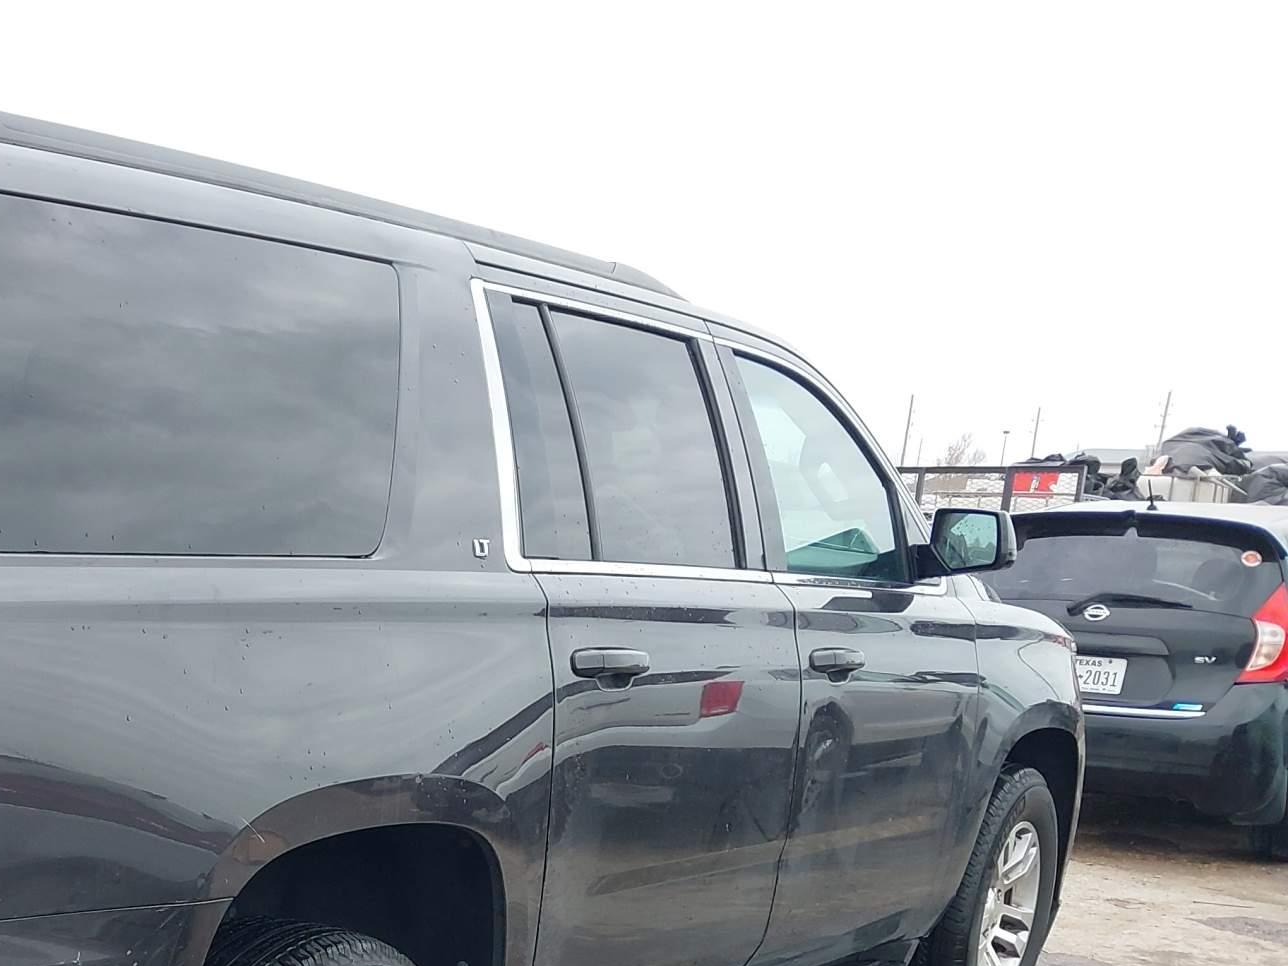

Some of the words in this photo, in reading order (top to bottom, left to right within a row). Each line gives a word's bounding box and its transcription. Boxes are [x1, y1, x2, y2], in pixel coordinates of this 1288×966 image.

[473, 538, 491, 557] LT
[1075, 658, 1103, 668] TEXAS
[1194, 656, 1217, 664] SV
[1083, 669, 1118, 687] 2031
